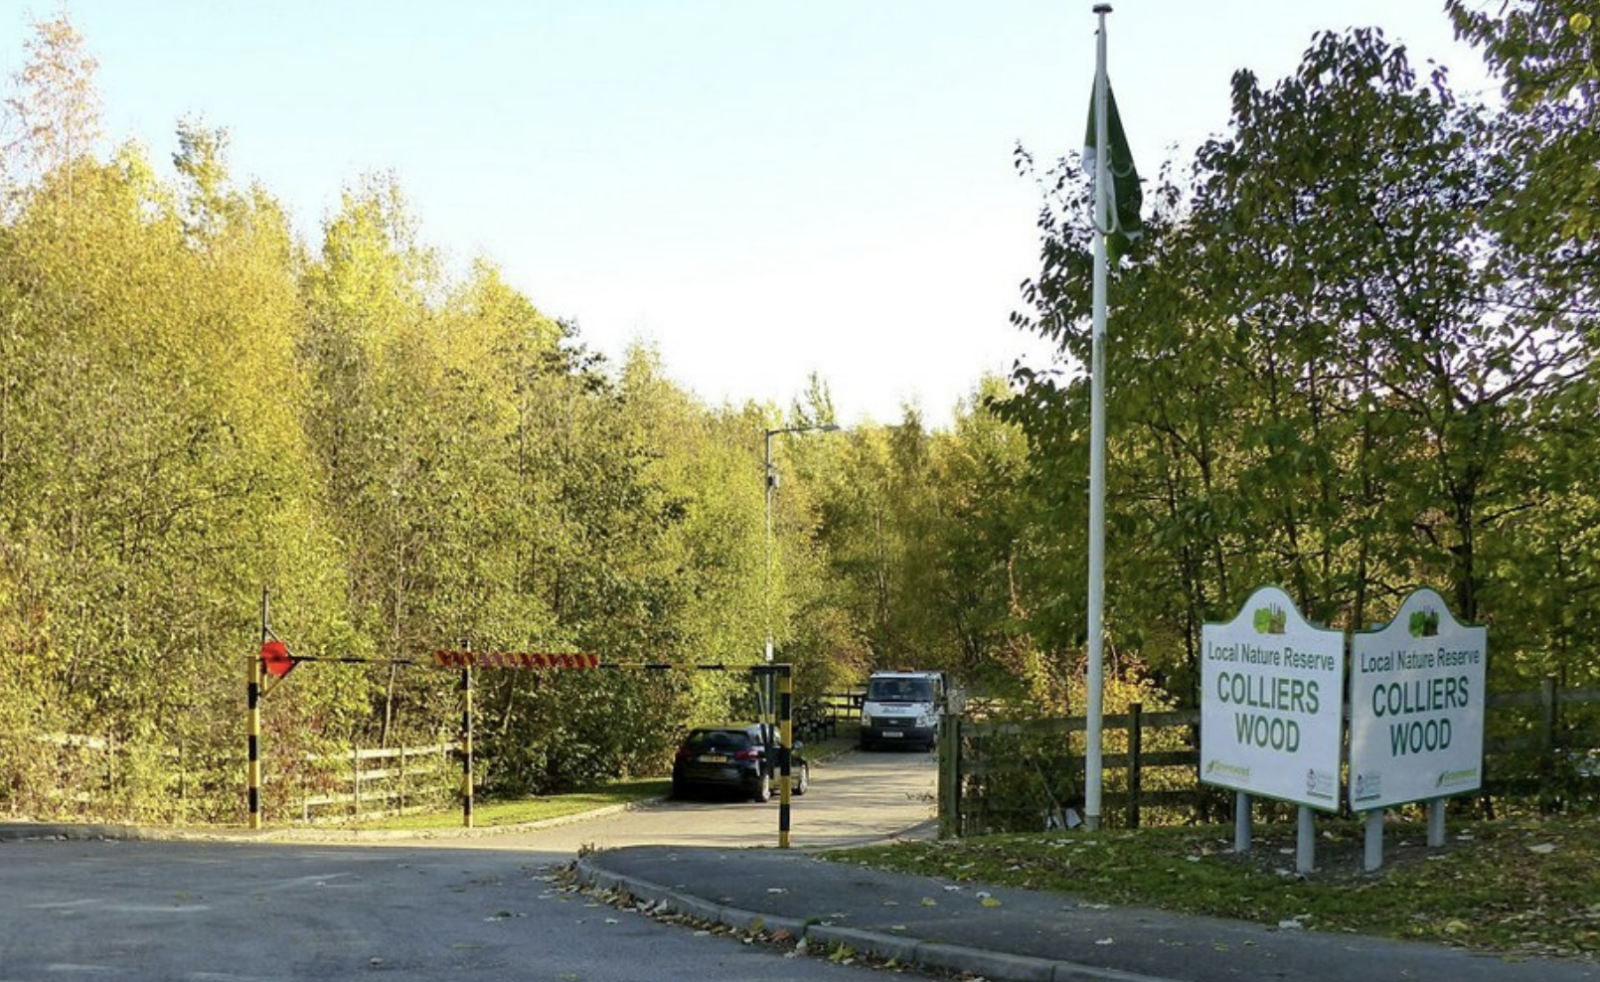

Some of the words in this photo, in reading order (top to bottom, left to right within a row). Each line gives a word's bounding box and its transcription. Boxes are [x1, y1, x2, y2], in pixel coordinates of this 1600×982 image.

[1208, 641, 1238, 661] Local
[1241, 643, 1280, 666] Nature
[1284, 647, 1335, 671] Reserve
[1361, 650, 1394, 673] Local
[1397, 649, 1435, 671] Nature
[1437, 647, 1480, 667] Reserve
[1217, 671, 1320, 715] COLLIERS
[1372, 675, 1469, 718] COLLIERS
[1234, 712, 1300, 753] WOOD
[1390, 718, 1452, 757] WOOD
